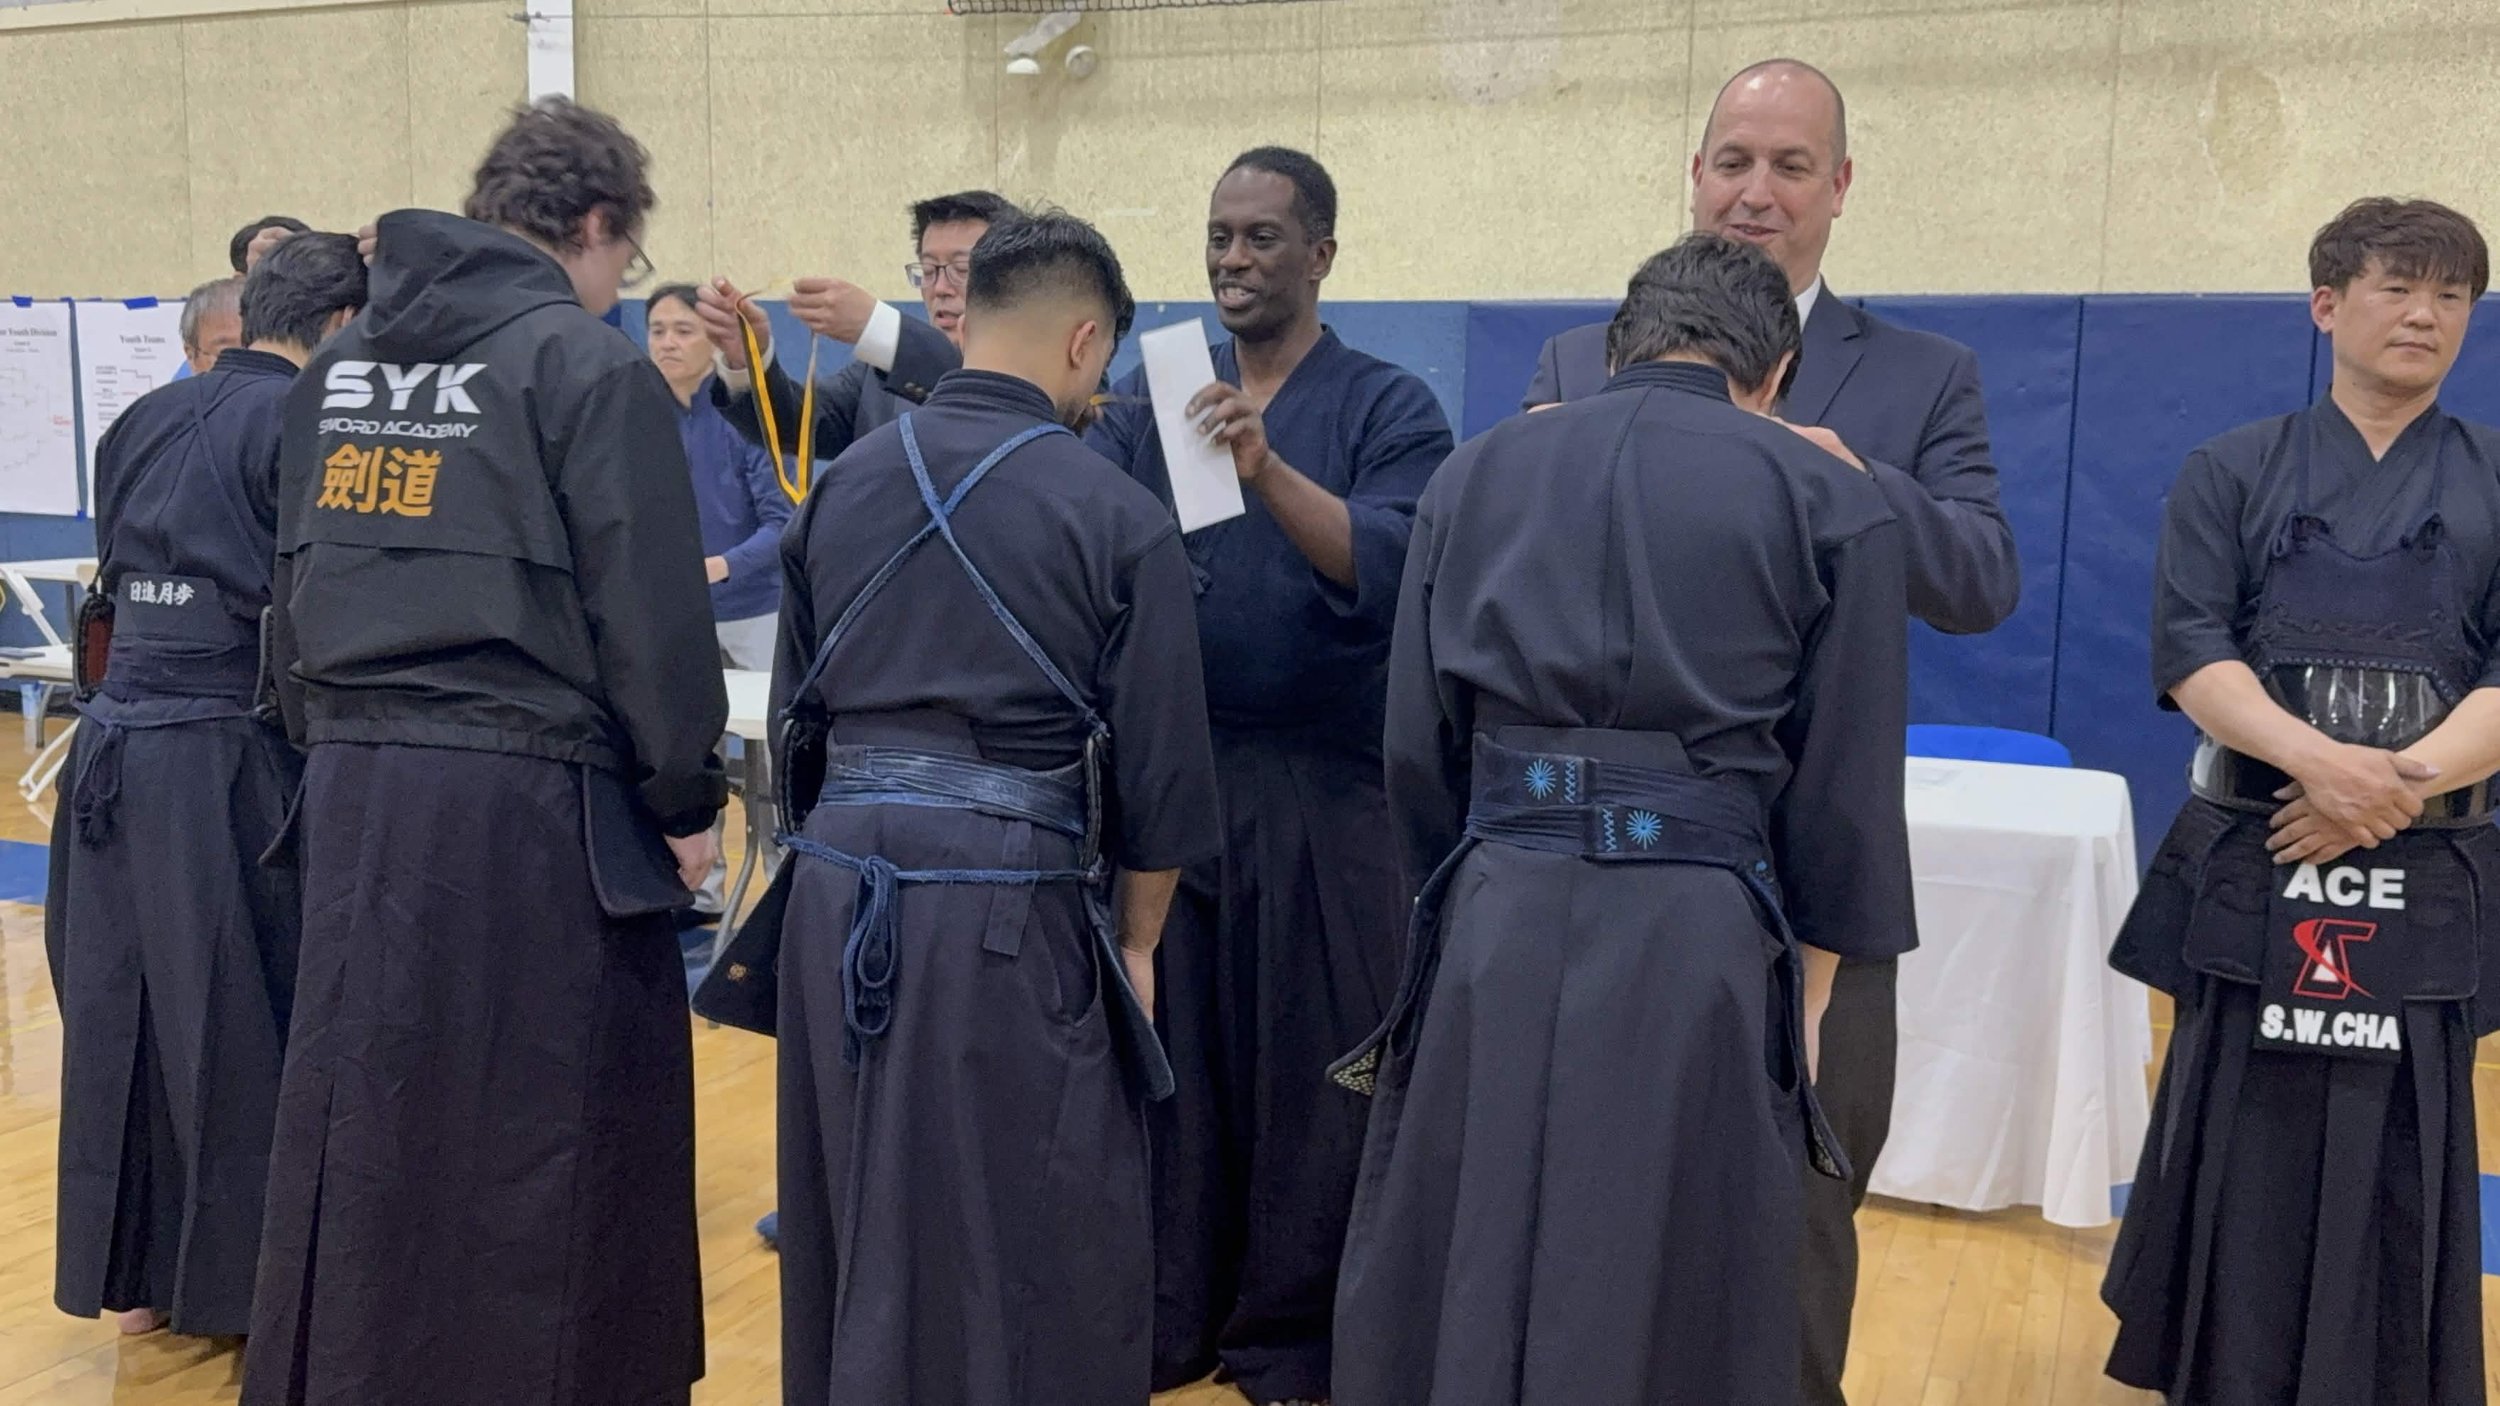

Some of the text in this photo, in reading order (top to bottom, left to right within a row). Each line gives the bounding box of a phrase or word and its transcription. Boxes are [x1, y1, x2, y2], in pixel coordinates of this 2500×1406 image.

[321, 360, 488, 414] SYK
[318, 417, 479, 439] SWORD ACADEMY
[2283, 863, 2406, 910] ACE
[2260, 1003, 2402, 1051] S.W.CHA
